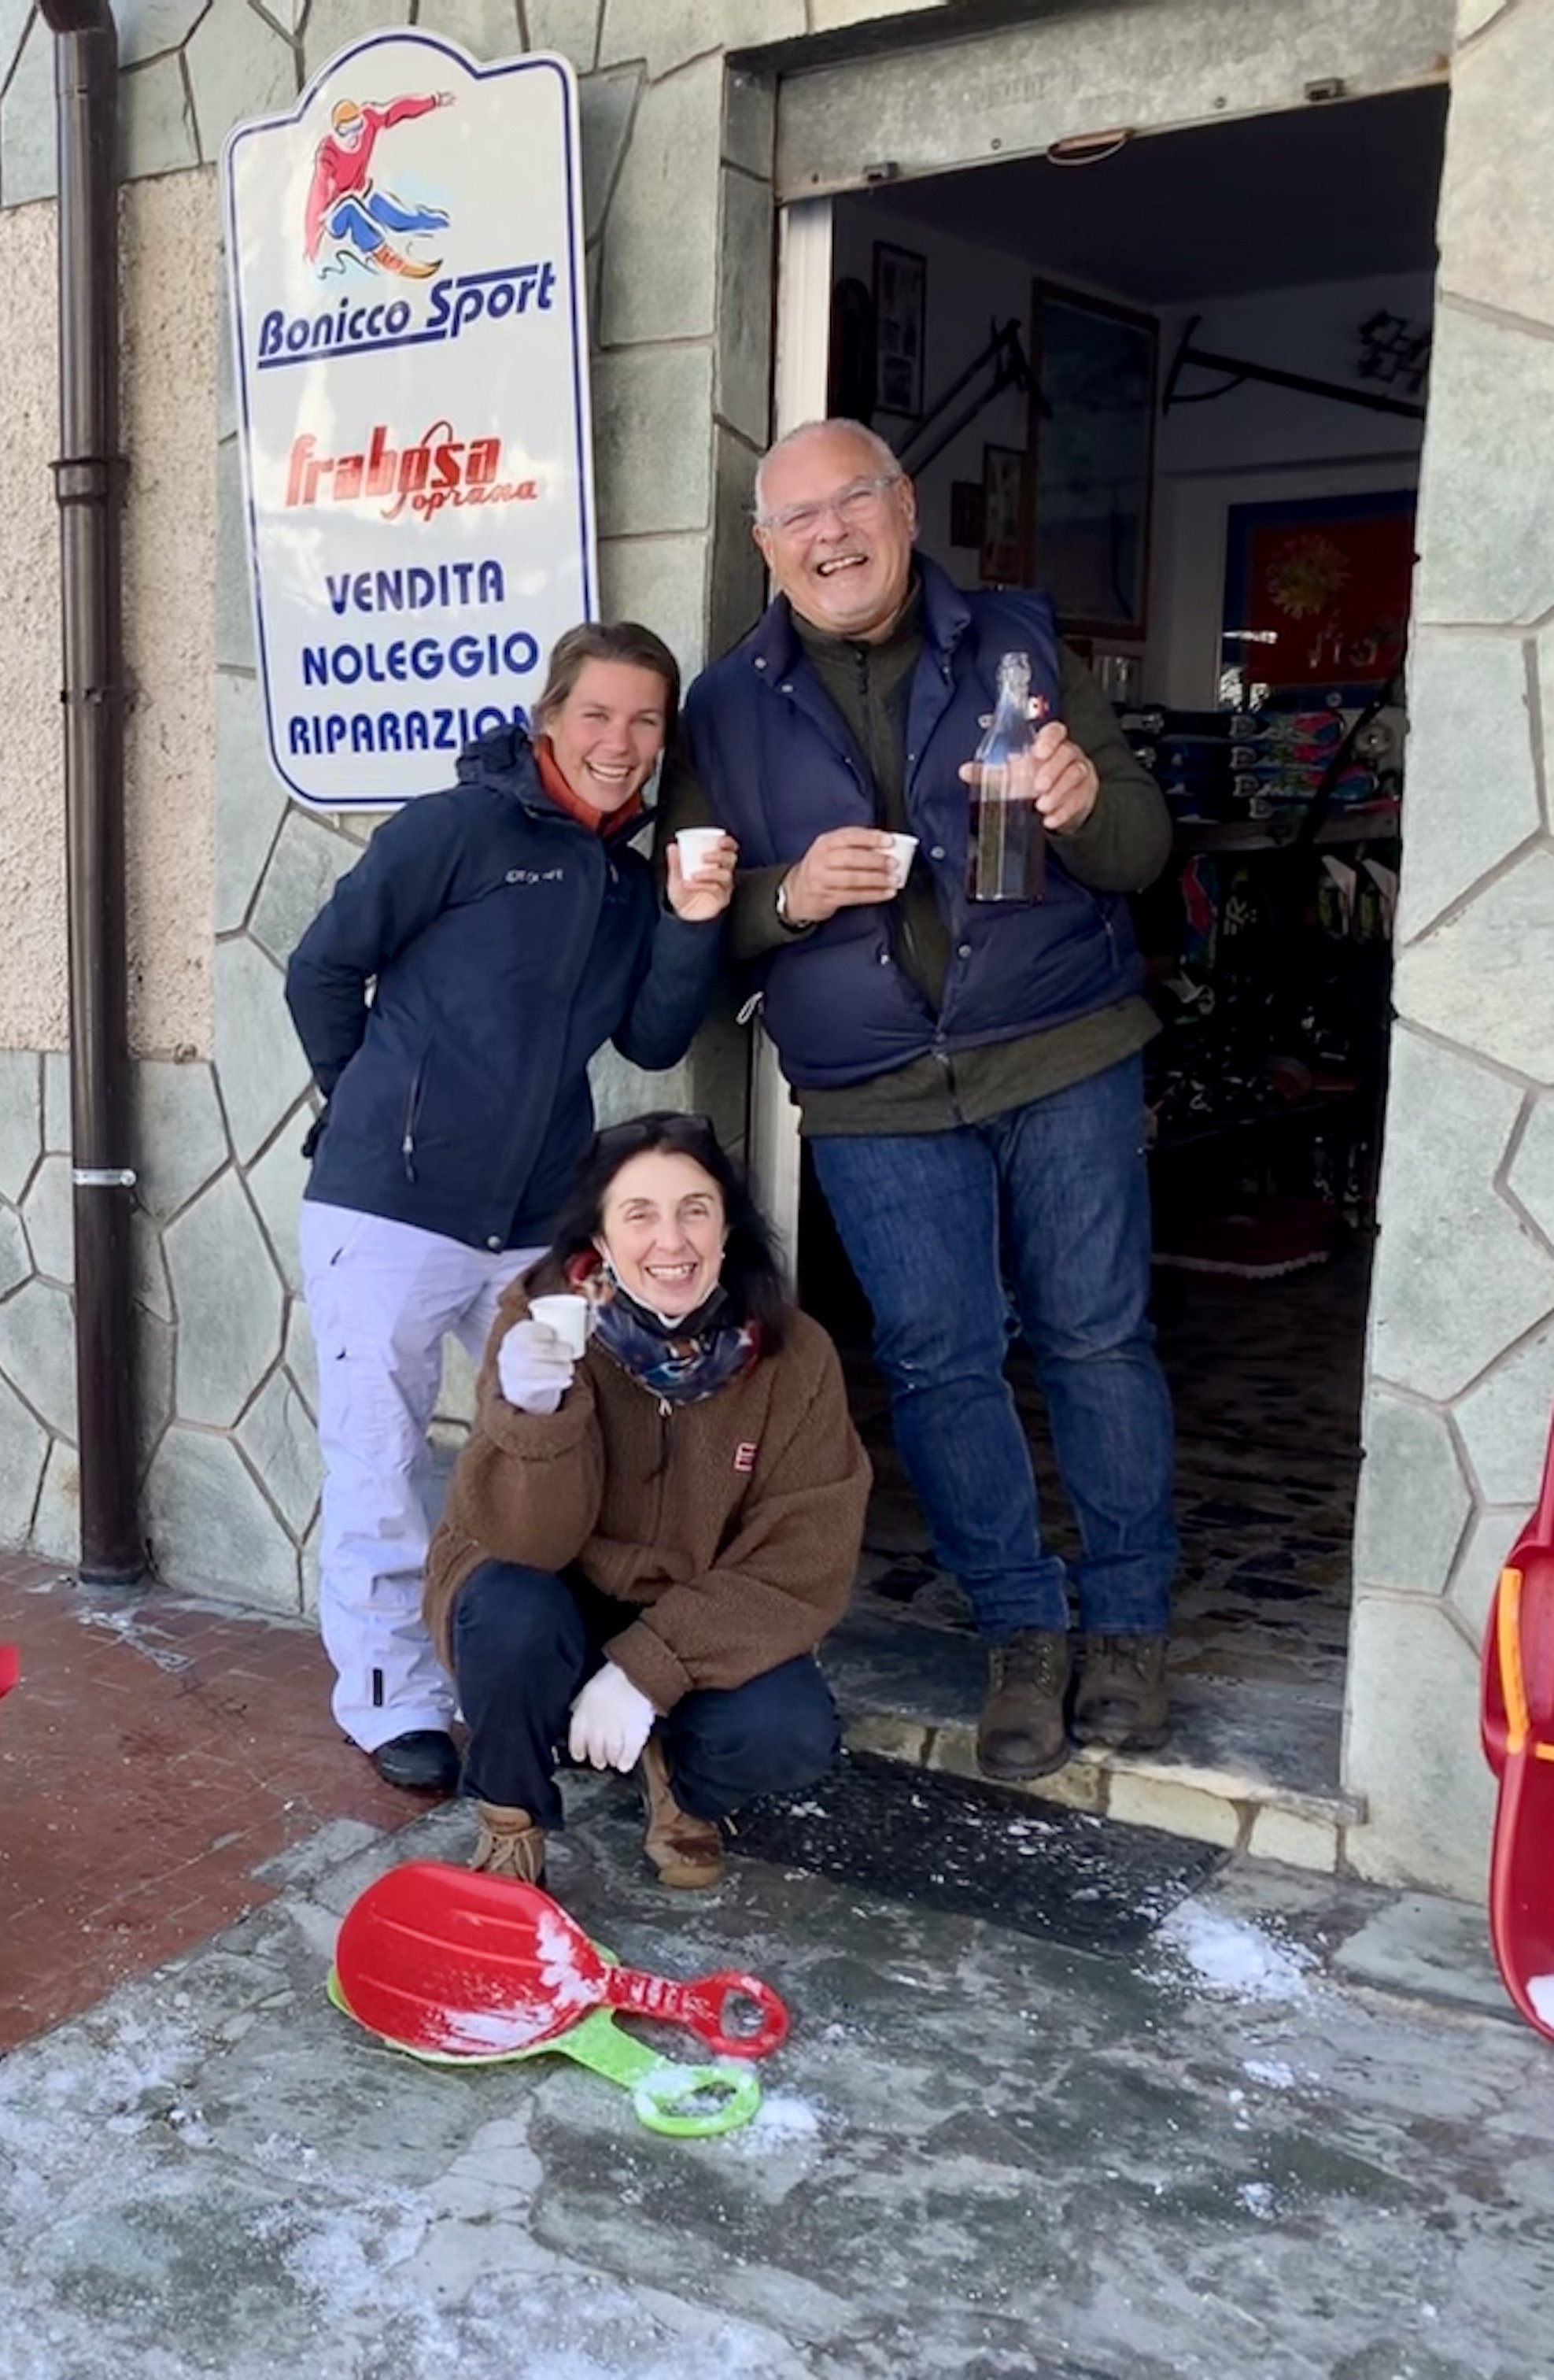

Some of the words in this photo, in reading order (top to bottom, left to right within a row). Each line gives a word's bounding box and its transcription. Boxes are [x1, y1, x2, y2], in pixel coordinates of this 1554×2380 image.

[258, 297, 412, 357] Bonicco
[426, 262, 556, 338] Sport
[326, 560, 504, 615] VENDITA
[303, 631, 539, 686] NOLEGGIO
